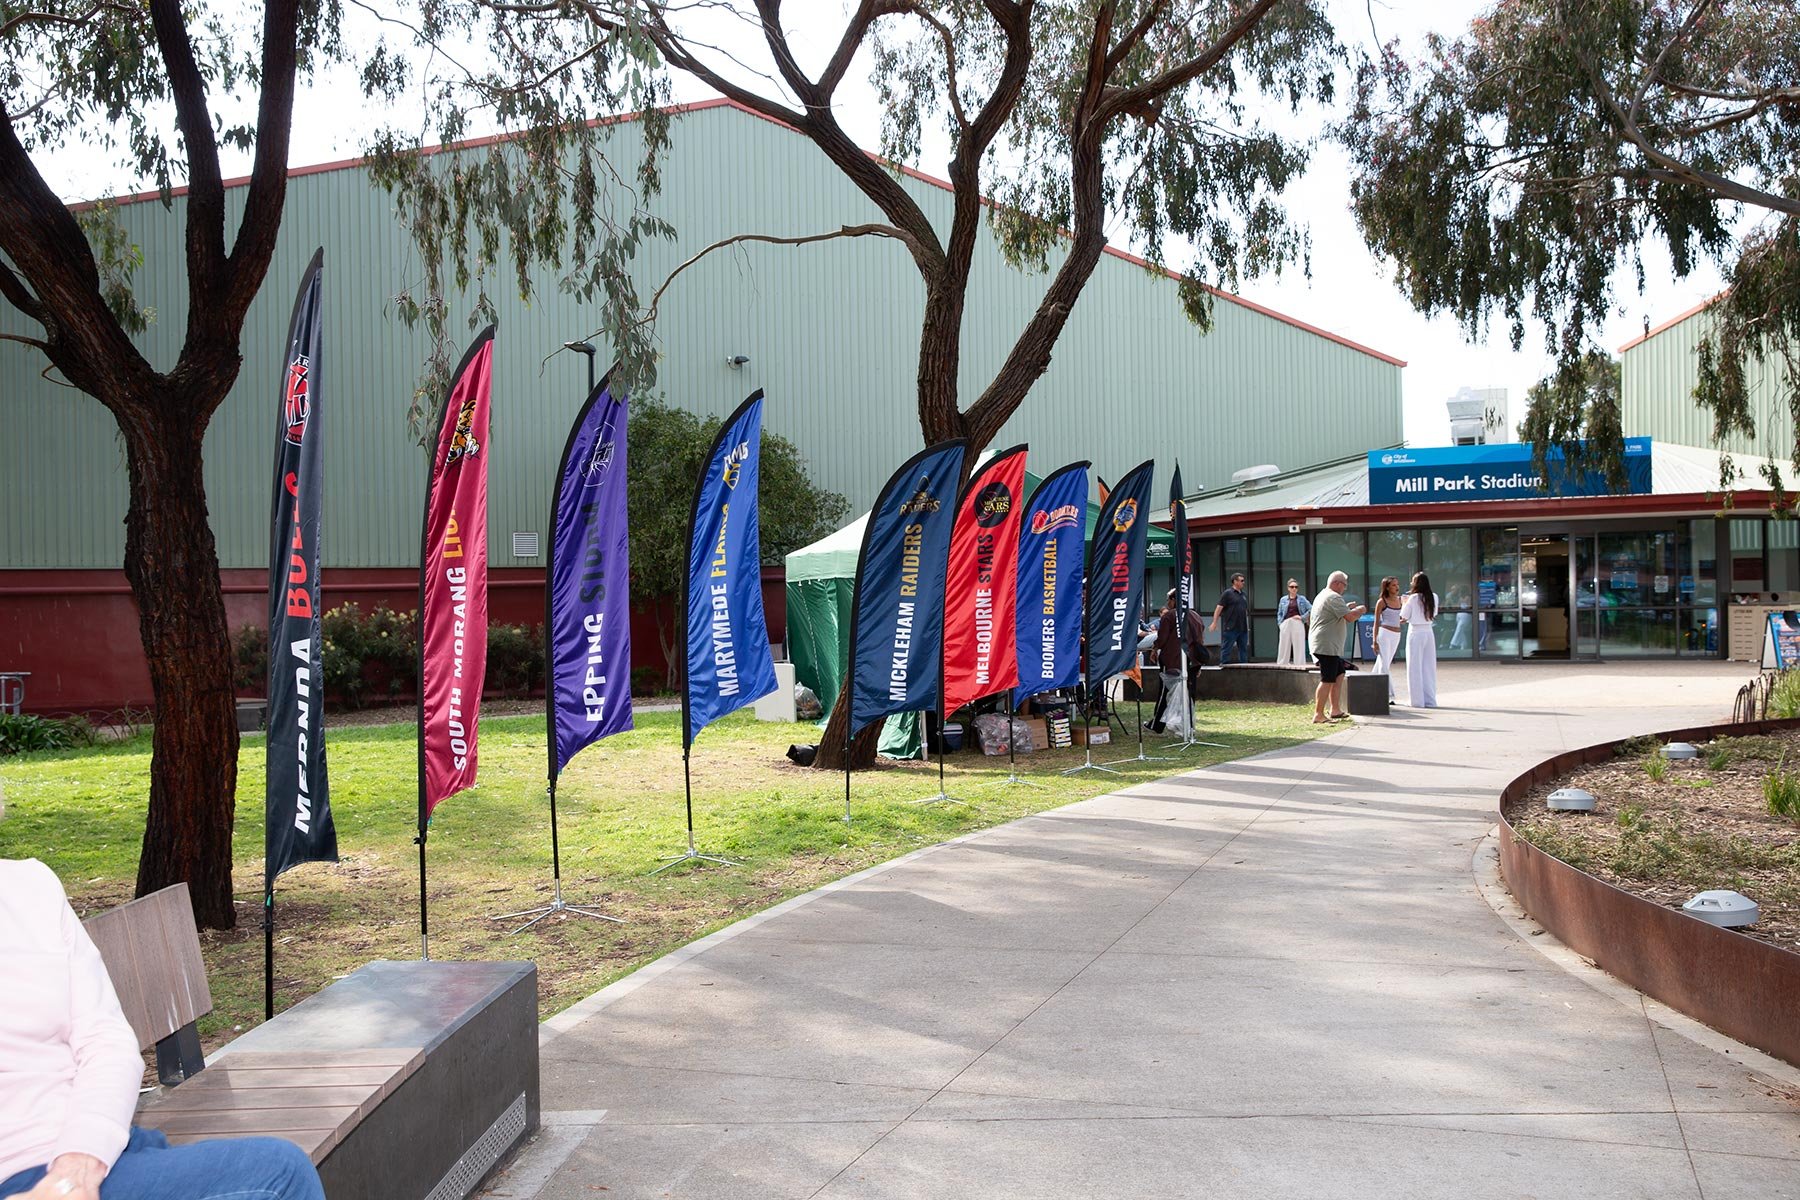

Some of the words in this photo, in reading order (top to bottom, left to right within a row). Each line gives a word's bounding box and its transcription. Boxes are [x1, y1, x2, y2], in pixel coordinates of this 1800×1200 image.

[1395, 477, 1428, 493] Mill
[1433, 475, 1476, 492] Park
[900, 523, 923, 597] RAIDERS
[978, 534, 994, 584] STARS
[1043, 538, 1057, 615] BASKETBALL
[1111, 541, 1129, 593] LIONS
[446, 567, 467, 678] MORANG
[711, 583, 740, 697] MARYMEDE
[889, 602, 915, 701] MICKLEHAM
[975, 588, 993, 685] MELBOURNE
[1041, 618, 1055, 679] BOOMERS
[1111, 597, 1128, 651] LALOR
[582, 613, 607, 722] EPPING
[448, 688, 468, 771] SOUTH
